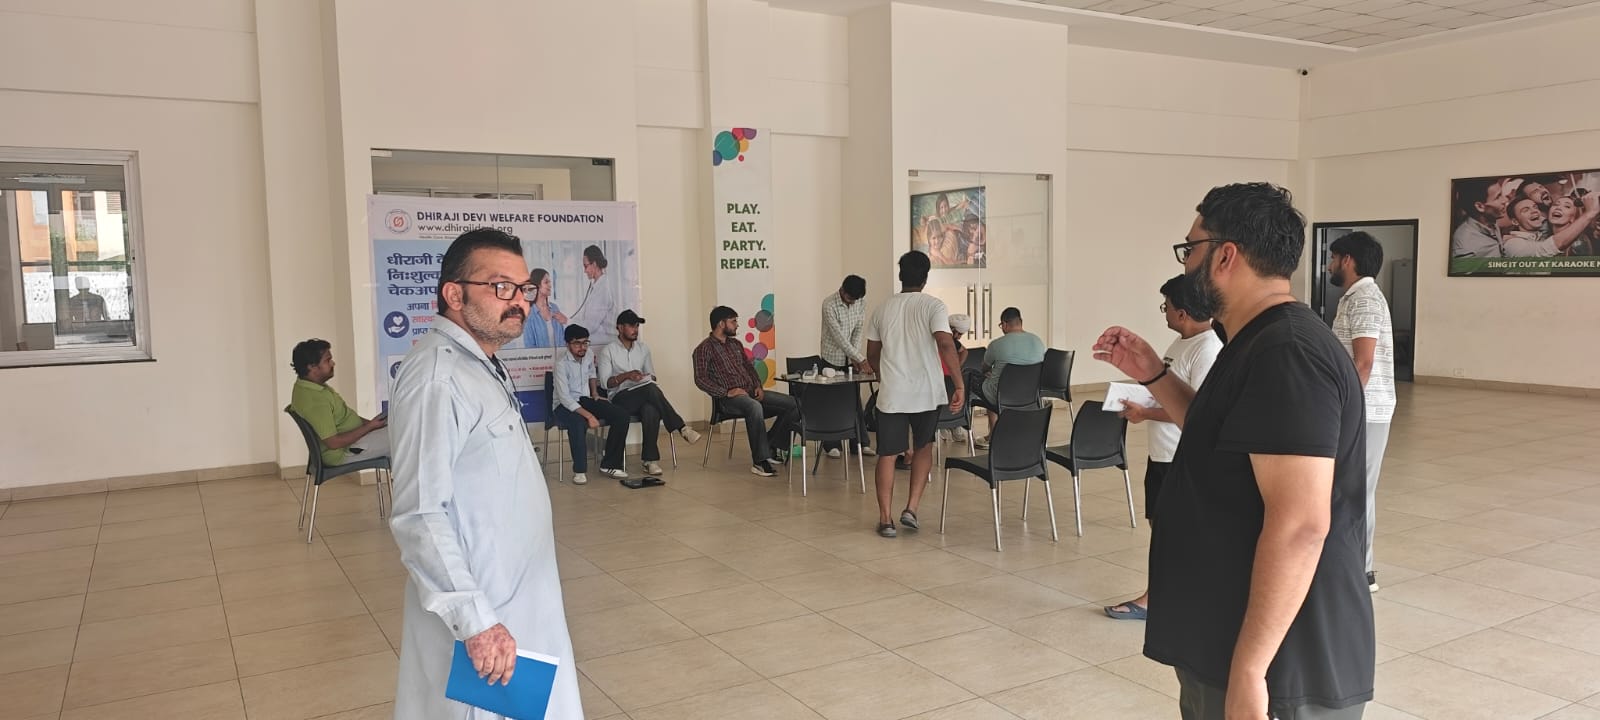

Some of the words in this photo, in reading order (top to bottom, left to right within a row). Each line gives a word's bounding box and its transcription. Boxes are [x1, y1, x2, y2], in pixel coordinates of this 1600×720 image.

[726, 203, 760, 214] PLAY.
[416, 211, 459, 221] DHIRAJI
[462, 212, 487, 222] DEVI
[489, 213, 535, 223] WELFARE
[537, 214, 604, 224] FOUNDATION
[731, 222, 757, 233] EAT.
[723, 240, 766, 251] PARTY.
[386, 252, 433, 266] धीराजी
[720, 258, 769, 269] REPEAT.
[1551, 260, 1596, 268] KARAOKE
